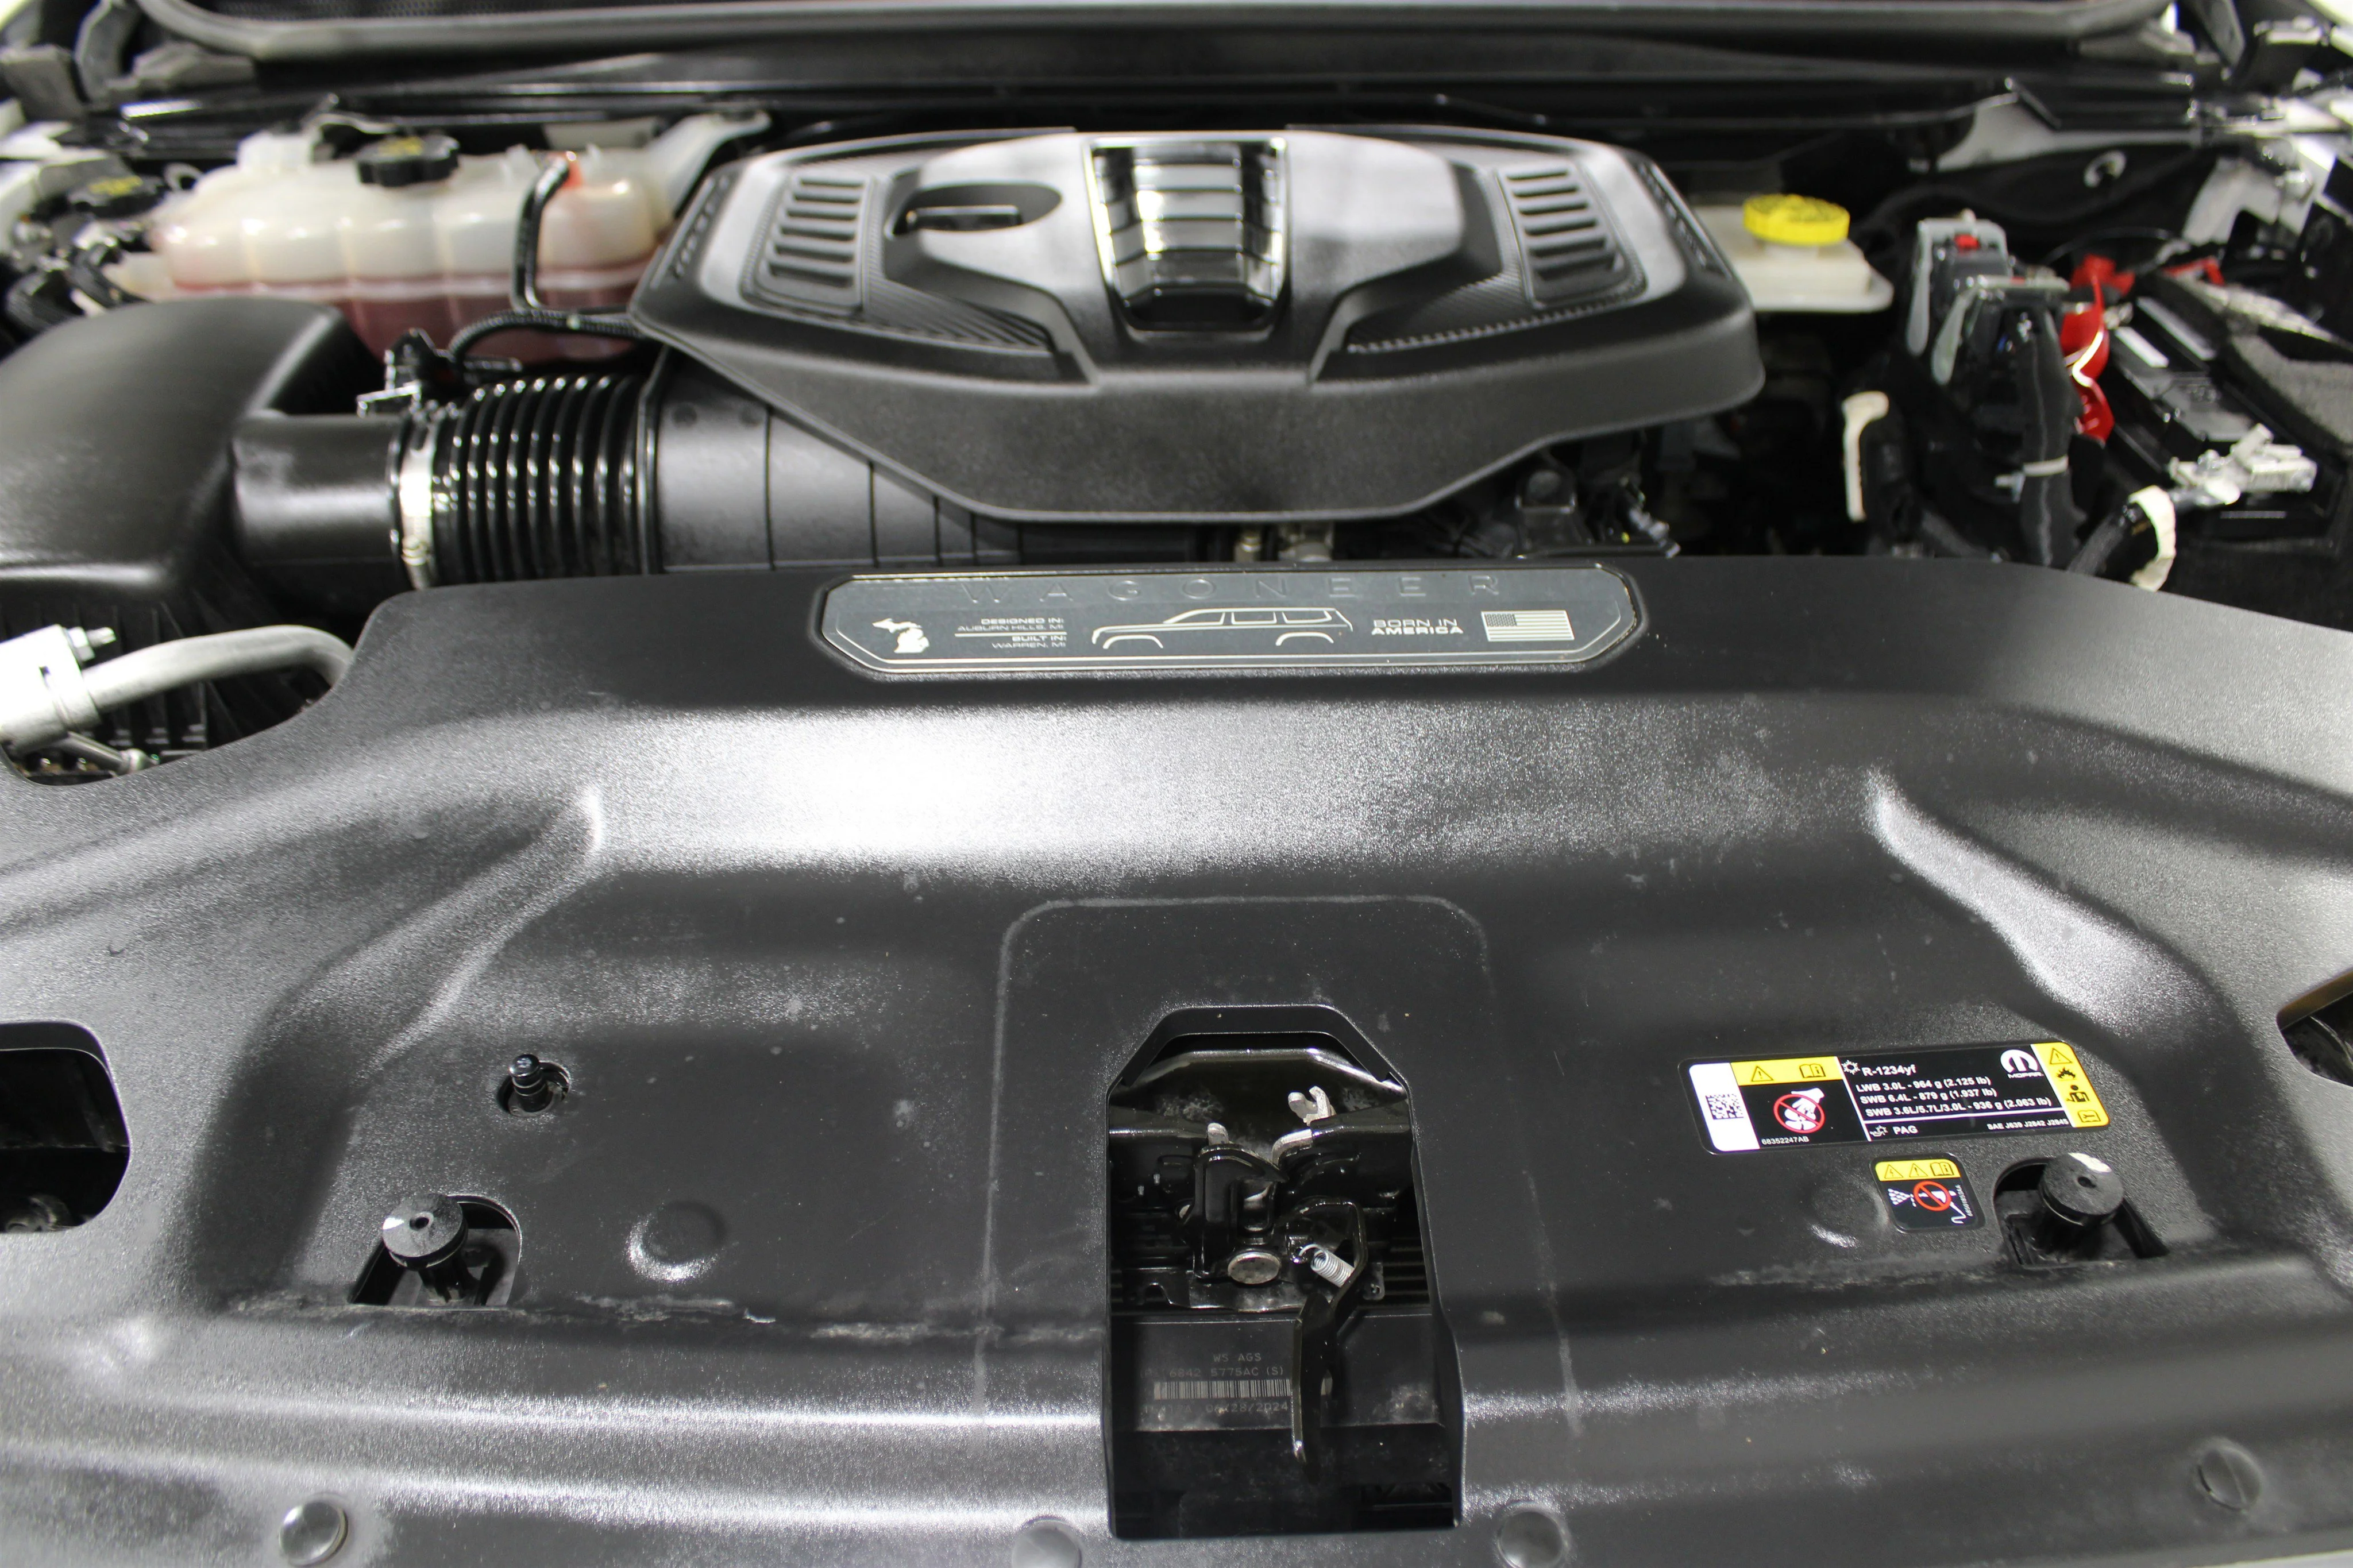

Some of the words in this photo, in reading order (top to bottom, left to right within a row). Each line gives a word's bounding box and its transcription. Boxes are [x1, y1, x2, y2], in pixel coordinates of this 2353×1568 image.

[961, 575, 1500, 603] WAGONEER
[1374, 619, 1430, 628] BORN
[1371, 626, 1464, 635] AMERICA
[1861, 1064, 1917, 1076] R-1234yf
[1856, 1083, 1881, 1092] LWB
[1883, 1082, 1906, 1091] 3.0L
[1912, 1080, 1932, 1089] 964
[1934, 1080, 1943, 1089] g
[1943, 1077, 1975, 1088] (2.125
[1976, 1076, 1992, 1086] lb)
[1860, 1095, 1887, 1104] SWB
[1888, 1094, 1912, 1102] 6.4L
[1918, 1092, 1938, 1100] 879
[1940, 1092, 1949, 1101] g
[1949, 1089, 1979, 1099] (1.937
[1981, 1088, 1997, 1098] lb)
[1865, 1107, 1893, 1117] SWB
[1893, 1102, 1966, 1115] 3.6L/5.7L/3.0L
[1973, 1100, 1993, 1110] 936
[1995, 1102, 2003, 1110] g
[2004, 1098, 2035, 1109] (2.063
[2036, 1097, 2052, 1106] lb)
[2005, 1121, 2023, 1129] J639
[2024, 1119, 2046, 1127] J2842
[2047, 1118, 2069, 1126] J2845
[1892, 1125, 1918, 1135] PAG
[1761, 1136, 1810, 1145] 68352247AB
[1213, 1353, 1229, 1362] WS
[1238, 1352, 1262, 1362] AGS
[1170, 1367, 1201, 1377] 6842
[1210, 1366, 1259, 1377] 5775AC
[1266, 1366, 1284, 1376] (S)
